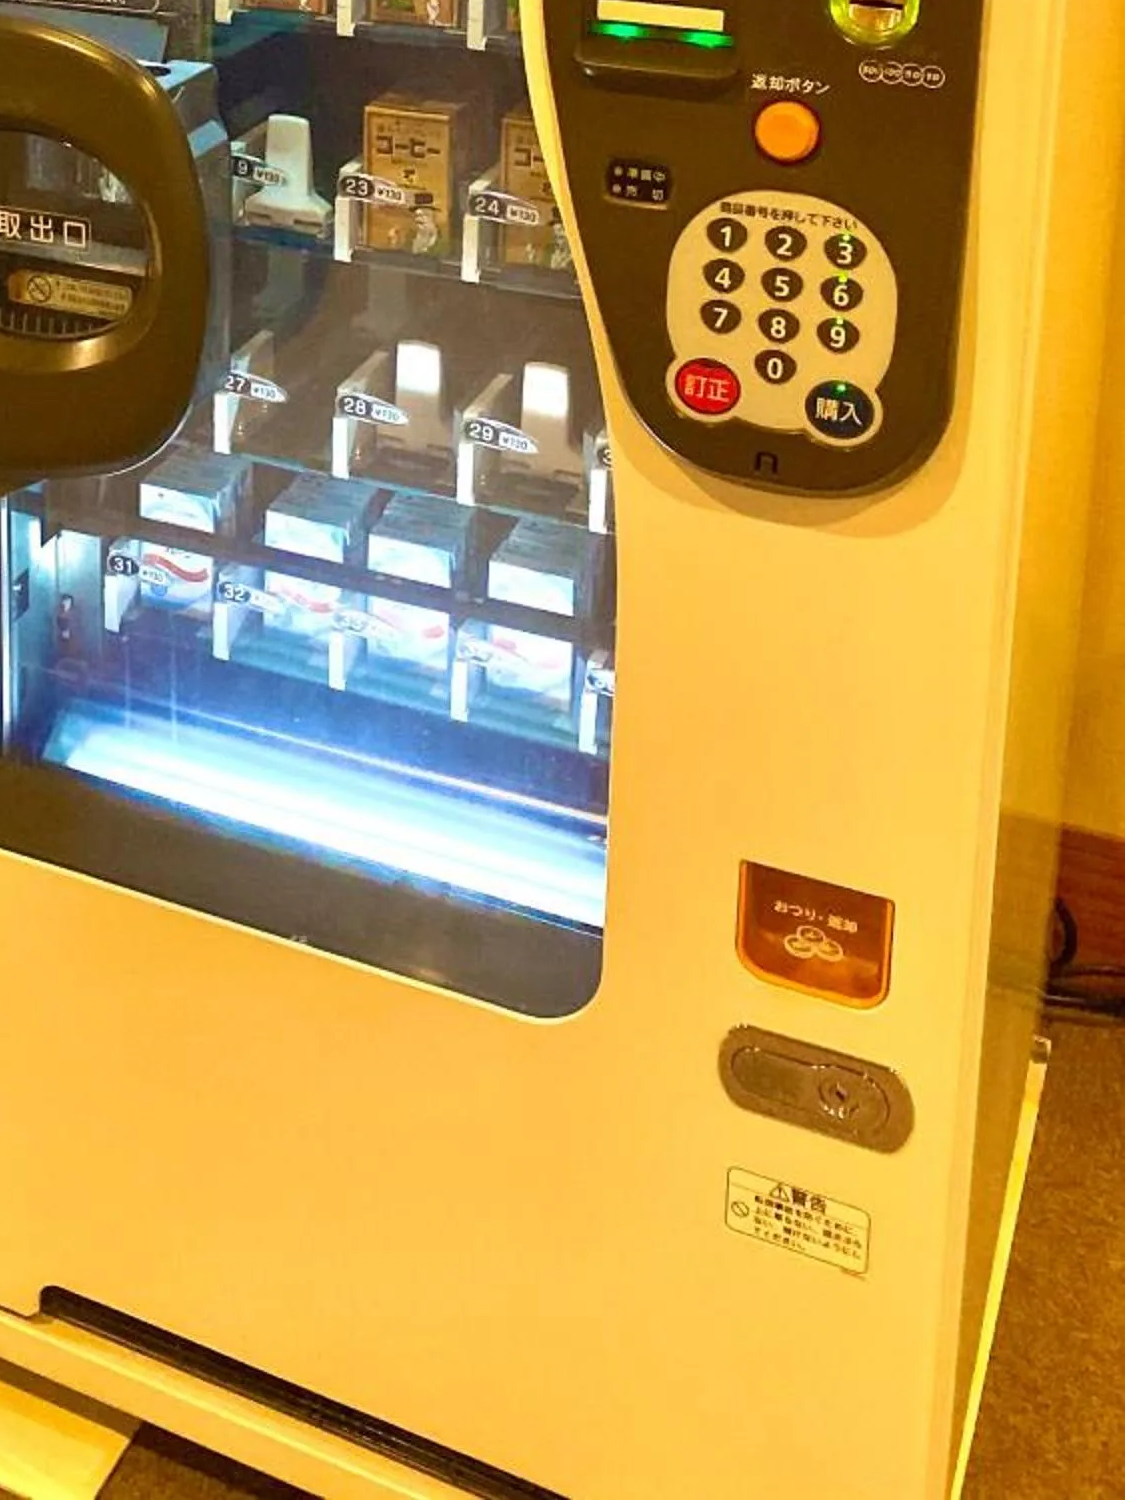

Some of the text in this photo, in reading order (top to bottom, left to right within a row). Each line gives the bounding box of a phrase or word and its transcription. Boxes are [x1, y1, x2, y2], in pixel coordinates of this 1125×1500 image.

[751, 72, 831, 95] 返却ボタン
[377, 135, 442, 158] コーヒー
[346, 179, 369, 195] 23
[475, 198, 500, 216] 24
[720, 225, 731, 247] 1
[778, 233, 793, 257] 2
[838, 243, 853, 264] 3
[714, 267, 732, 289] 4
[775, 275, 790, 297] 5
[833, 284, 849, 307] 6
[713, 307, 728, 329] 7
[771, 316, 786, 339] 8
[829, 325, 846, 349] 9
[766, 357, 784, 380] 0
[224, 375, 247, 392] 27
[684, 373, 731, 403] 訂正
[343, 397, 367, 415] 28
[815, 396, 863, 426] 購入
[470, 423, 493, 441] 29
[602, 450, 612, 466] 3
[114, 557, 133, 575] 31
[225, 585, 244, 601] 32
